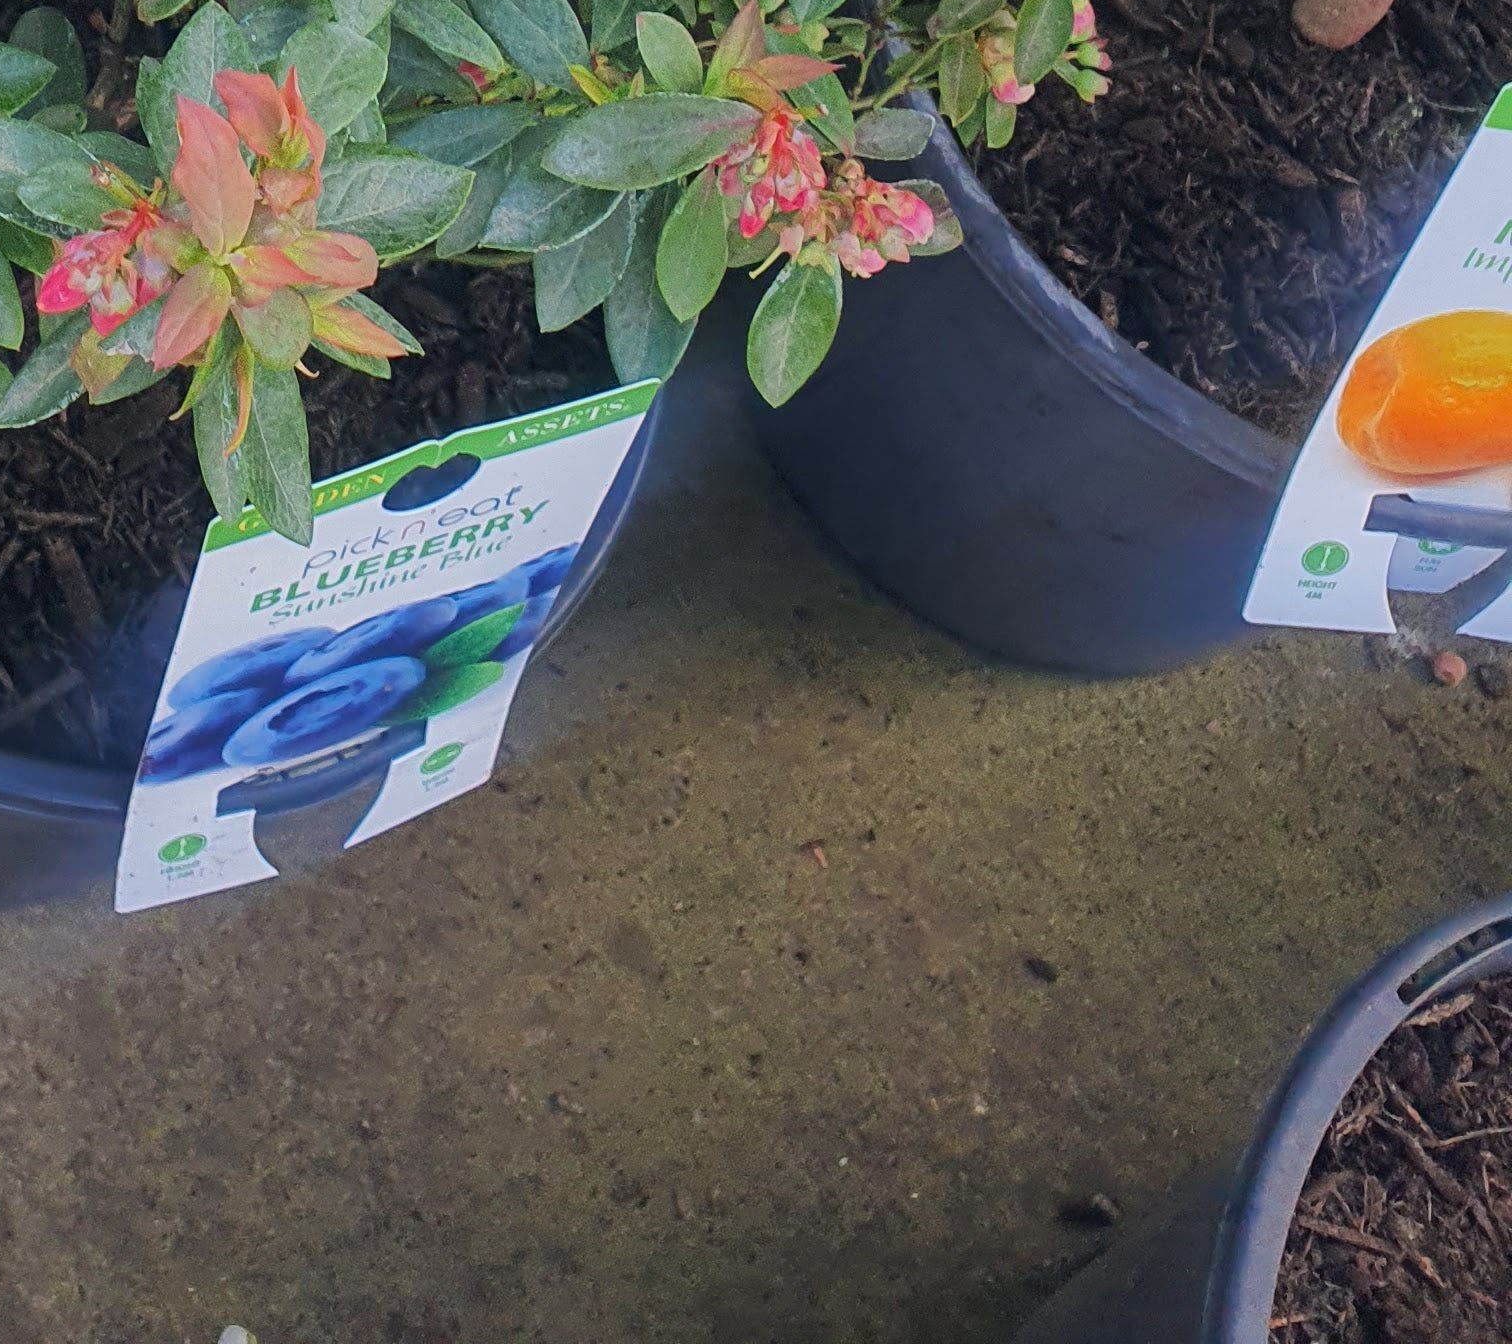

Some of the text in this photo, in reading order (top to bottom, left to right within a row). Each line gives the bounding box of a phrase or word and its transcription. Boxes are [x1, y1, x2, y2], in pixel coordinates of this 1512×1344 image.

[238, 399, 626, 532] GDEN ASSETS
[249, 499, 550, 613] BLUEBERRY
[269, 535, 513, 626] Sunshine Blue
[1297, 579, 1337, 590] HEIGHT
